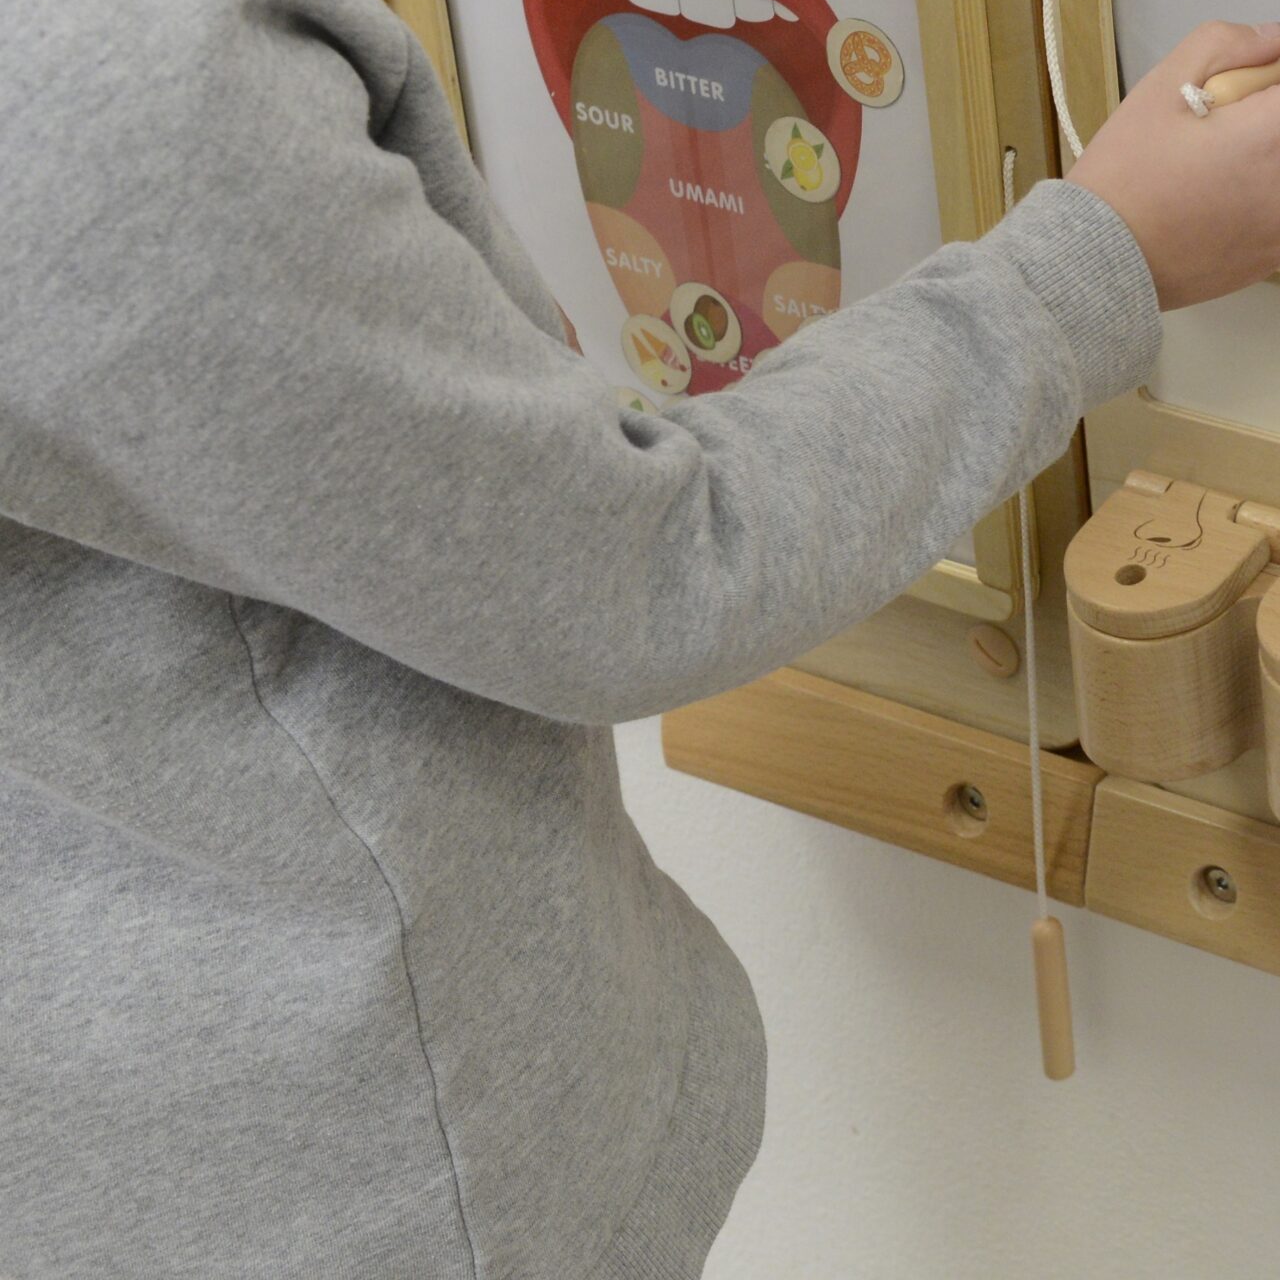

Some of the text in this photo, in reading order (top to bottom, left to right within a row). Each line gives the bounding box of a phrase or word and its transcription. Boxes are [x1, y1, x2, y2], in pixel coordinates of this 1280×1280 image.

[655, 67, 725, 102] BITTER
[575, 101, 634, 133] SOUR
[669, 177, 744, 215] UMAMI
[606, 247, 662, 278] SALTY
